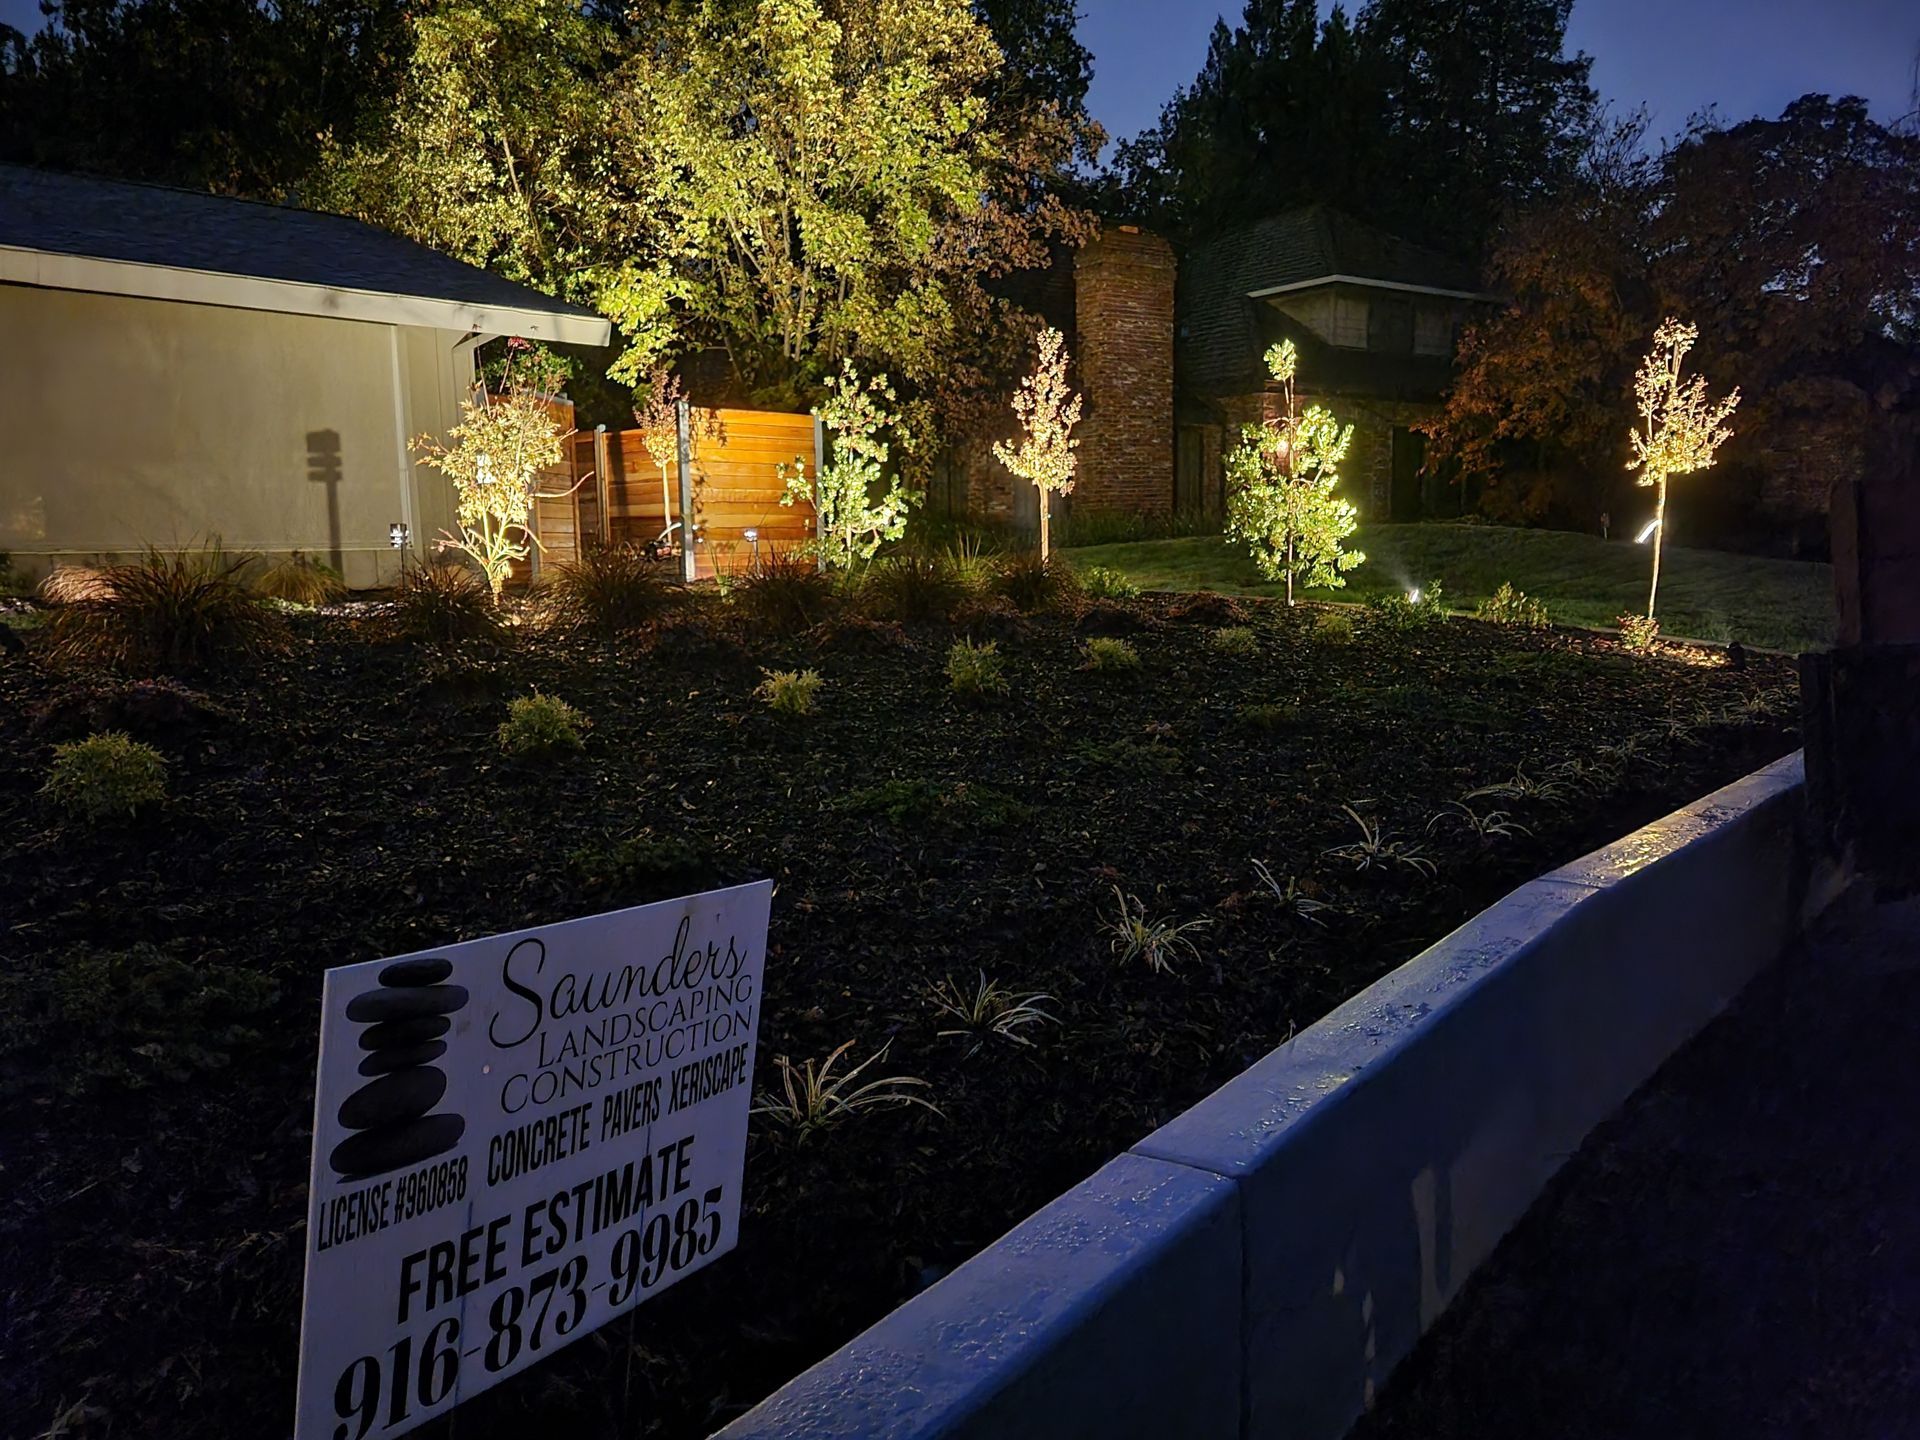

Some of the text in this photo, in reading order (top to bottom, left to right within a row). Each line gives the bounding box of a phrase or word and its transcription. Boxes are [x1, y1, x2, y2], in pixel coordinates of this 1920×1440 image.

[489, 916, 748, 1048] Saunders
[539, 975, 752, 1068] LANDSCAPING
[487, 1042, 749, 1187] CONCRETE PAVERS XERISCAPE
[501, 1005, 752, 1113] CONSTRUCTION
[318, 1155, 468, 1252] LICENSE #960858
[397, 1135, 695, 1324] FREE ESTIMATE
[332, 1185, 723, 1440] 916-873-9985
